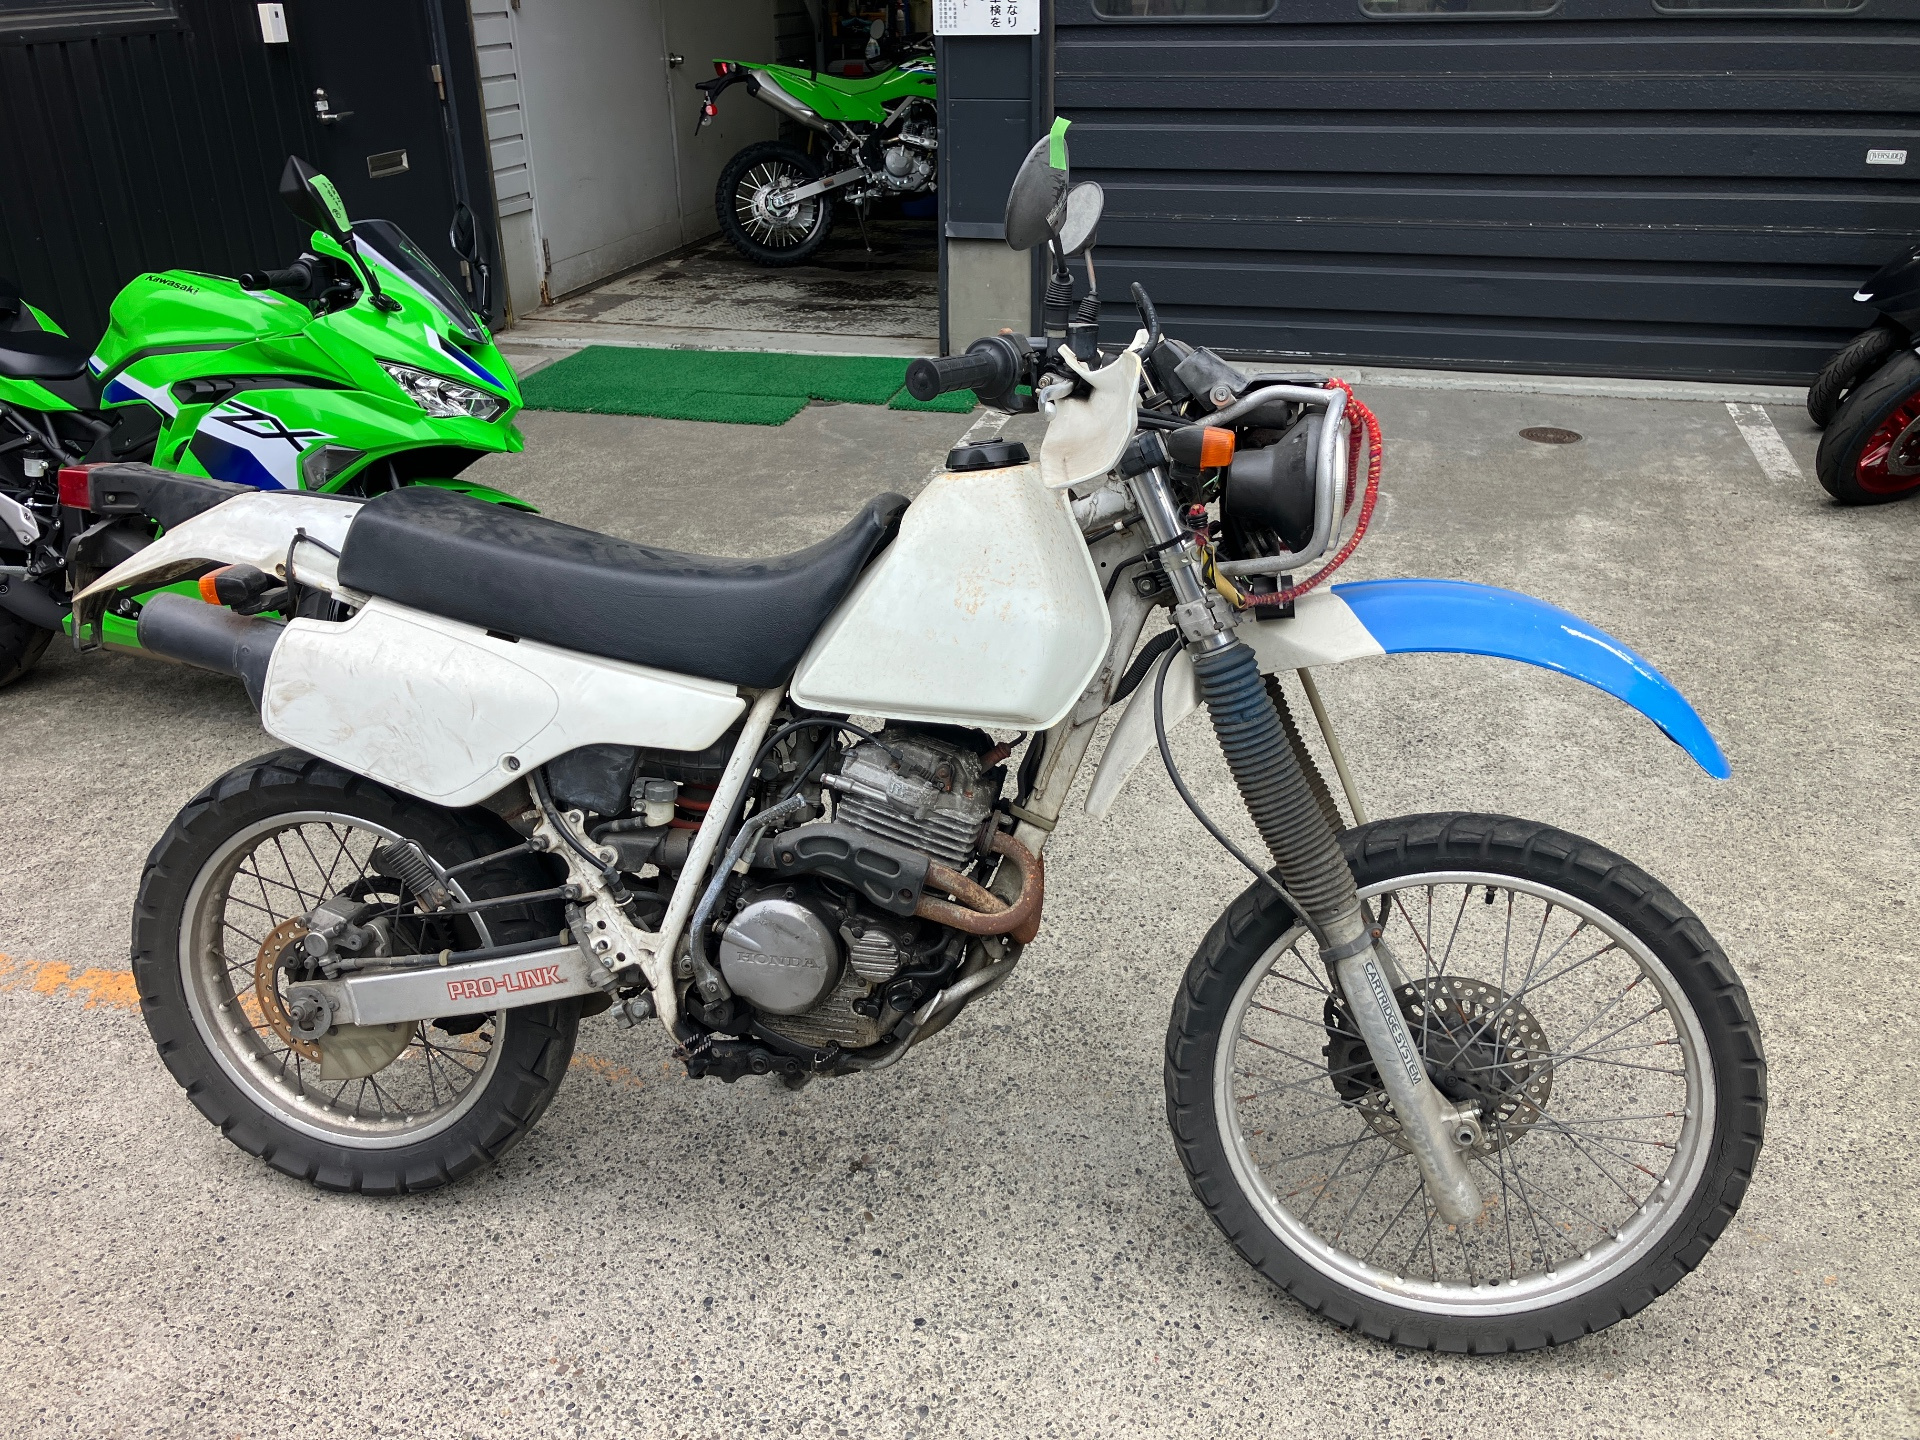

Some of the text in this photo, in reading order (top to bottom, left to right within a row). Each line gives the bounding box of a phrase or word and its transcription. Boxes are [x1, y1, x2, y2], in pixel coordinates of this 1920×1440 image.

[145, 274, 200, 296] Kawasaki
[210, 400, 327, 453] ZX
[736, 951, 821, 969] HONDA
[447, 965, 561, 1000] PRO-LINK
[1364, 961, 1422, 1085] CARTRIDGE SYSTEM
